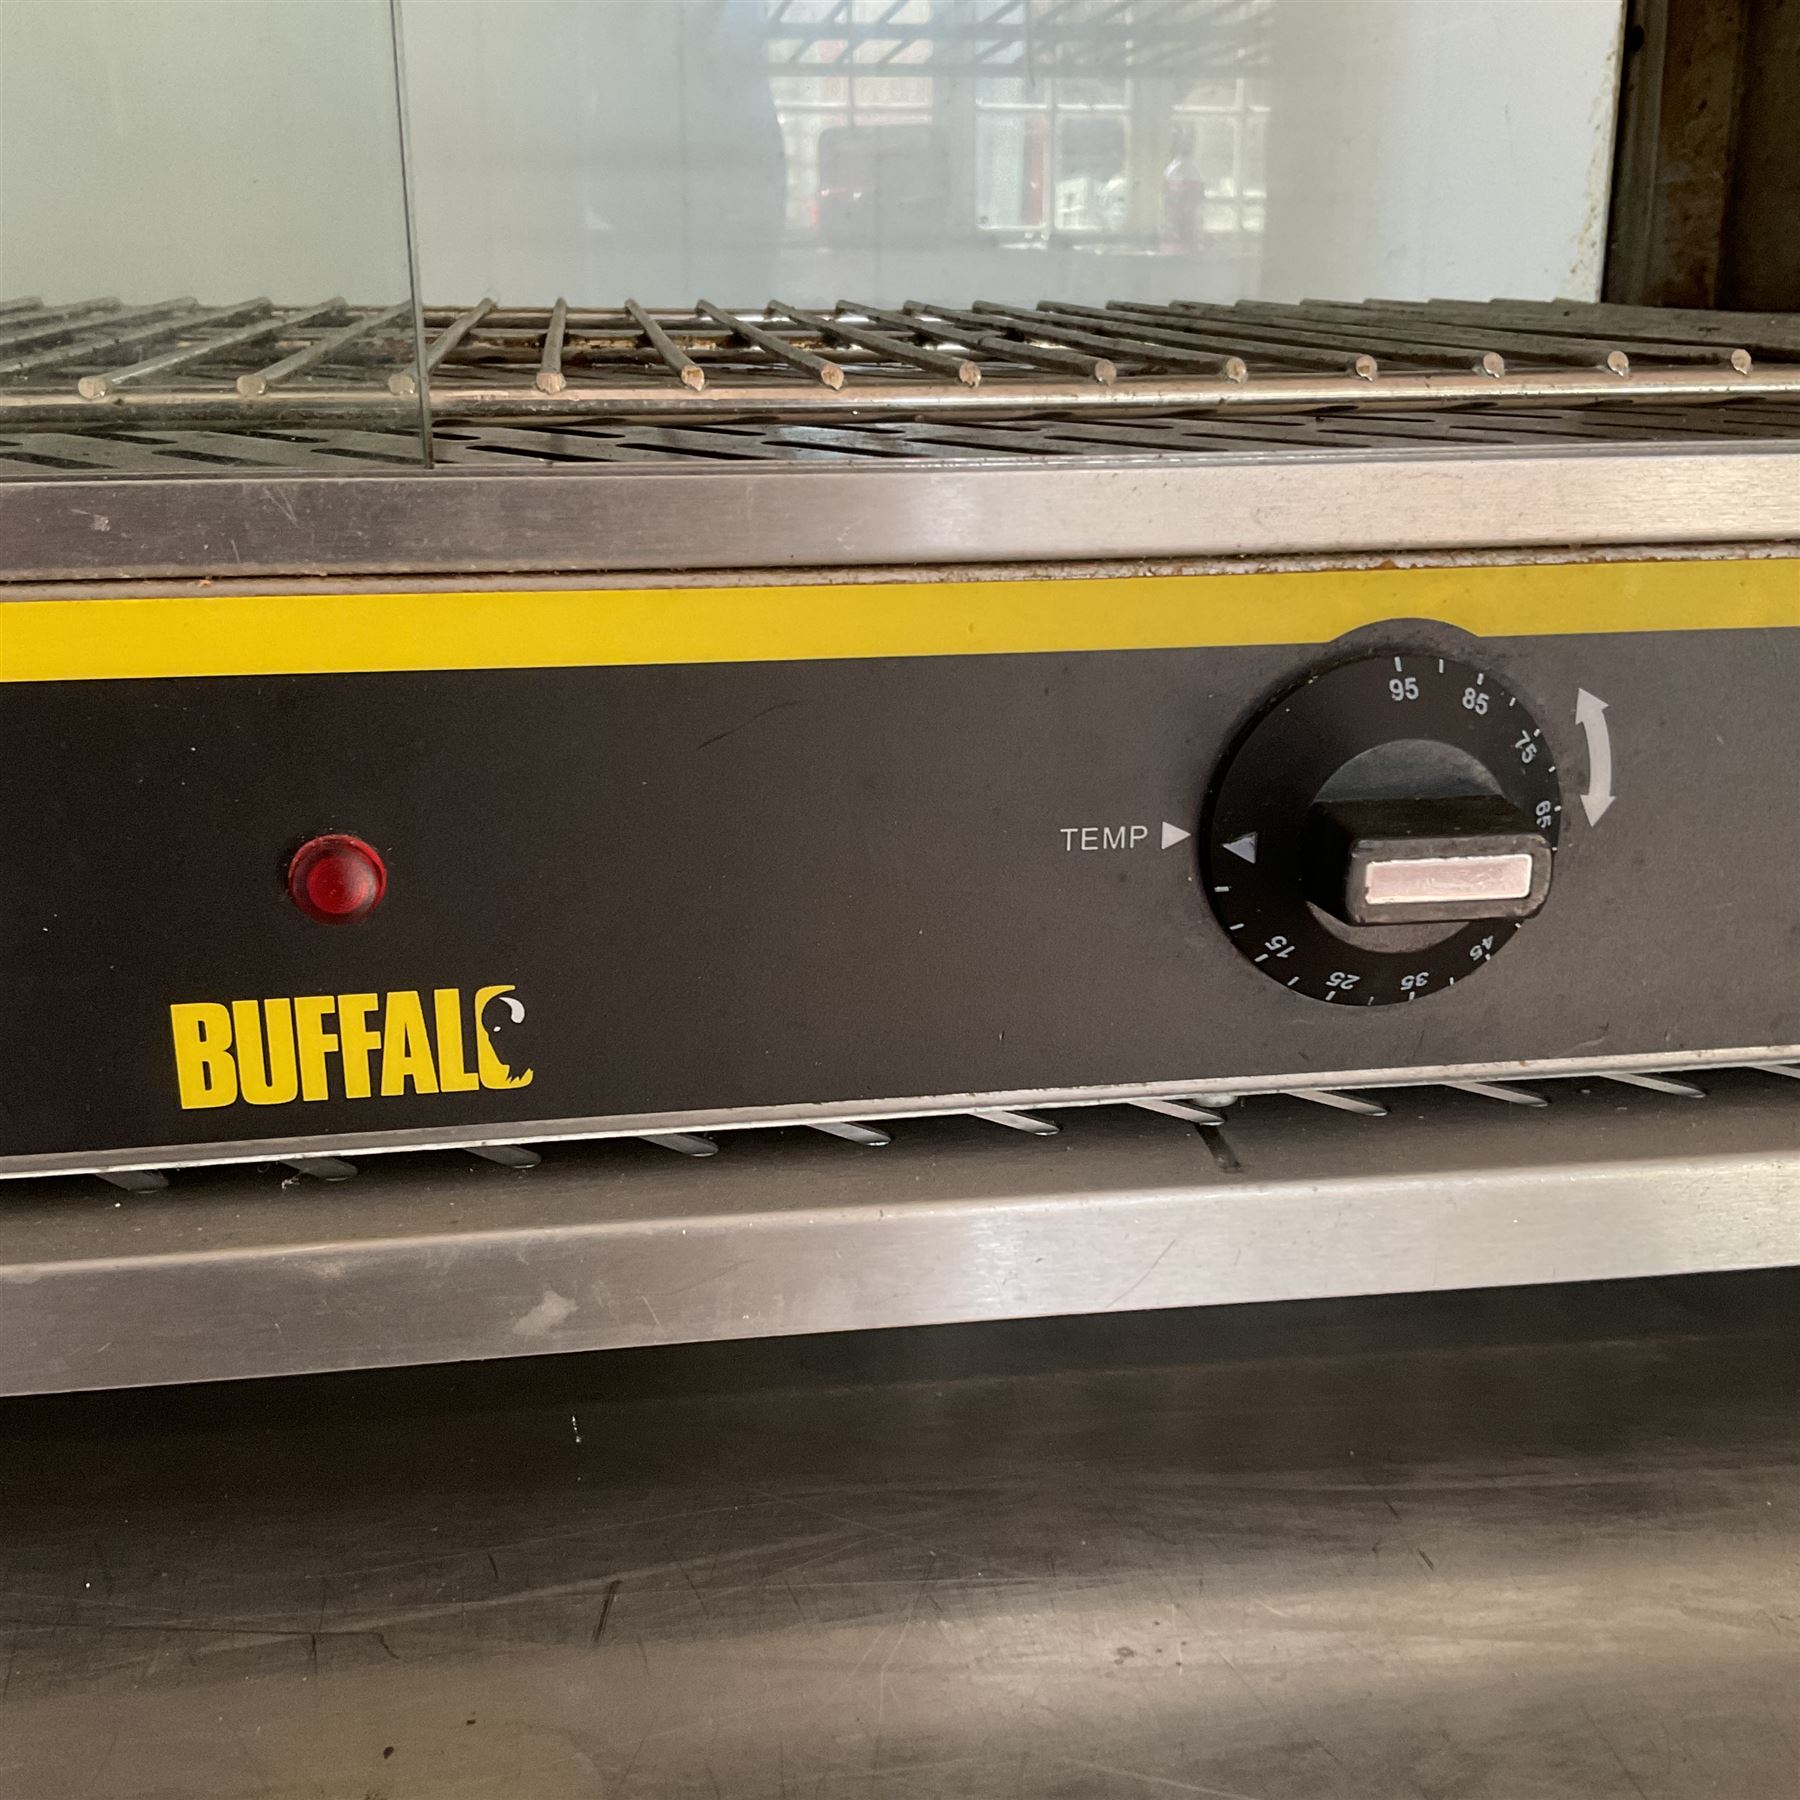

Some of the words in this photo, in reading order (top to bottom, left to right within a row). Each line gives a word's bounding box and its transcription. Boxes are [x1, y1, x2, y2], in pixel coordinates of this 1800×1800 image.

[1389, 677, 1419, 702] 95
[1462, 687, 1490, 716] 85
[1515, 730, 1537, 763] 75
[1060, 826, 1149, 851] TEMP
[1264, 935, 1296, 960] 15
[1469, 935, 1495, 961] 45
[1326, 971, 1360, 991] 25
[1400, 971, 1430, 991] 35
[170, 985, 534, 1110] BUFFALO
